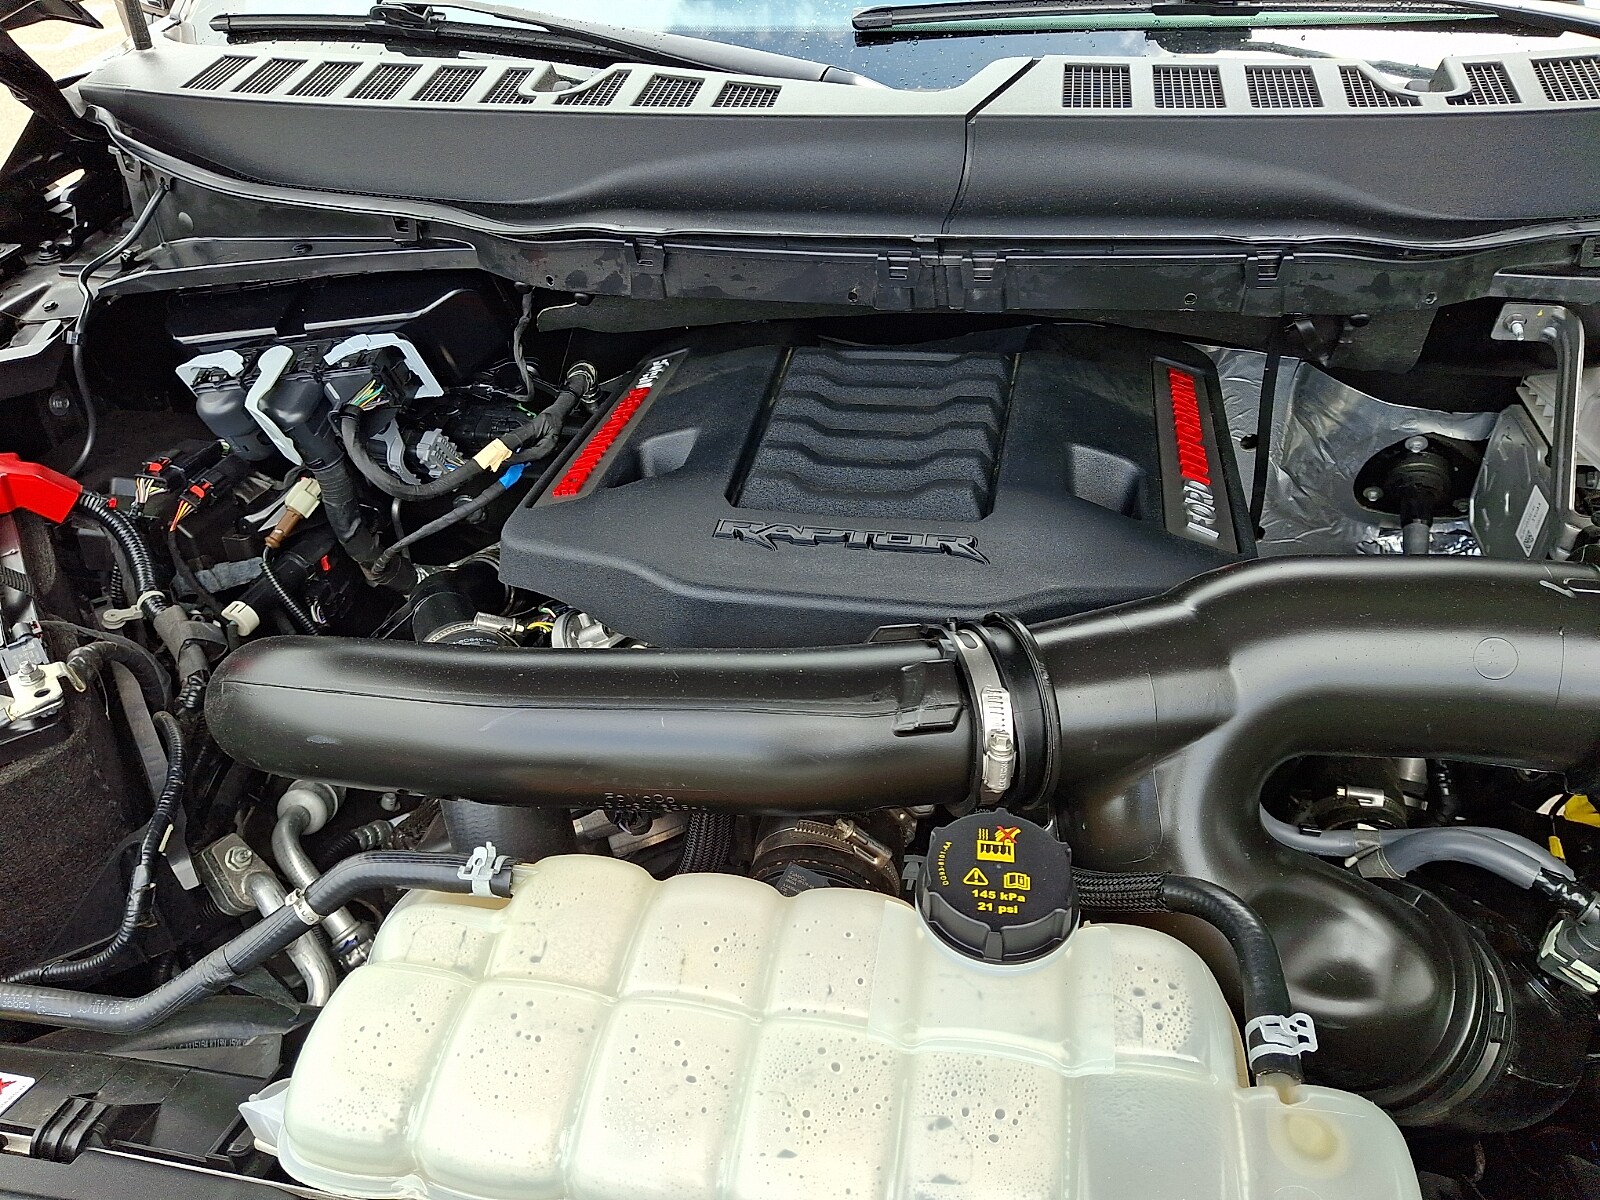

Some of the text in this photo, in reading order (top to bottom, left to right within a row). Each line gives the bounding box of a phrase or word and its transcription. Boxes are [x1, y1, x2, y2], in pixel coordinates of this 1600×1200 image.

[1182, 480, 1220, 539] FORD
[711, 518, 991, 565] RAPTOR
[971, 889, 1026, 903] 145 kPa
[977, 901, 1019, 915] 21 psi
